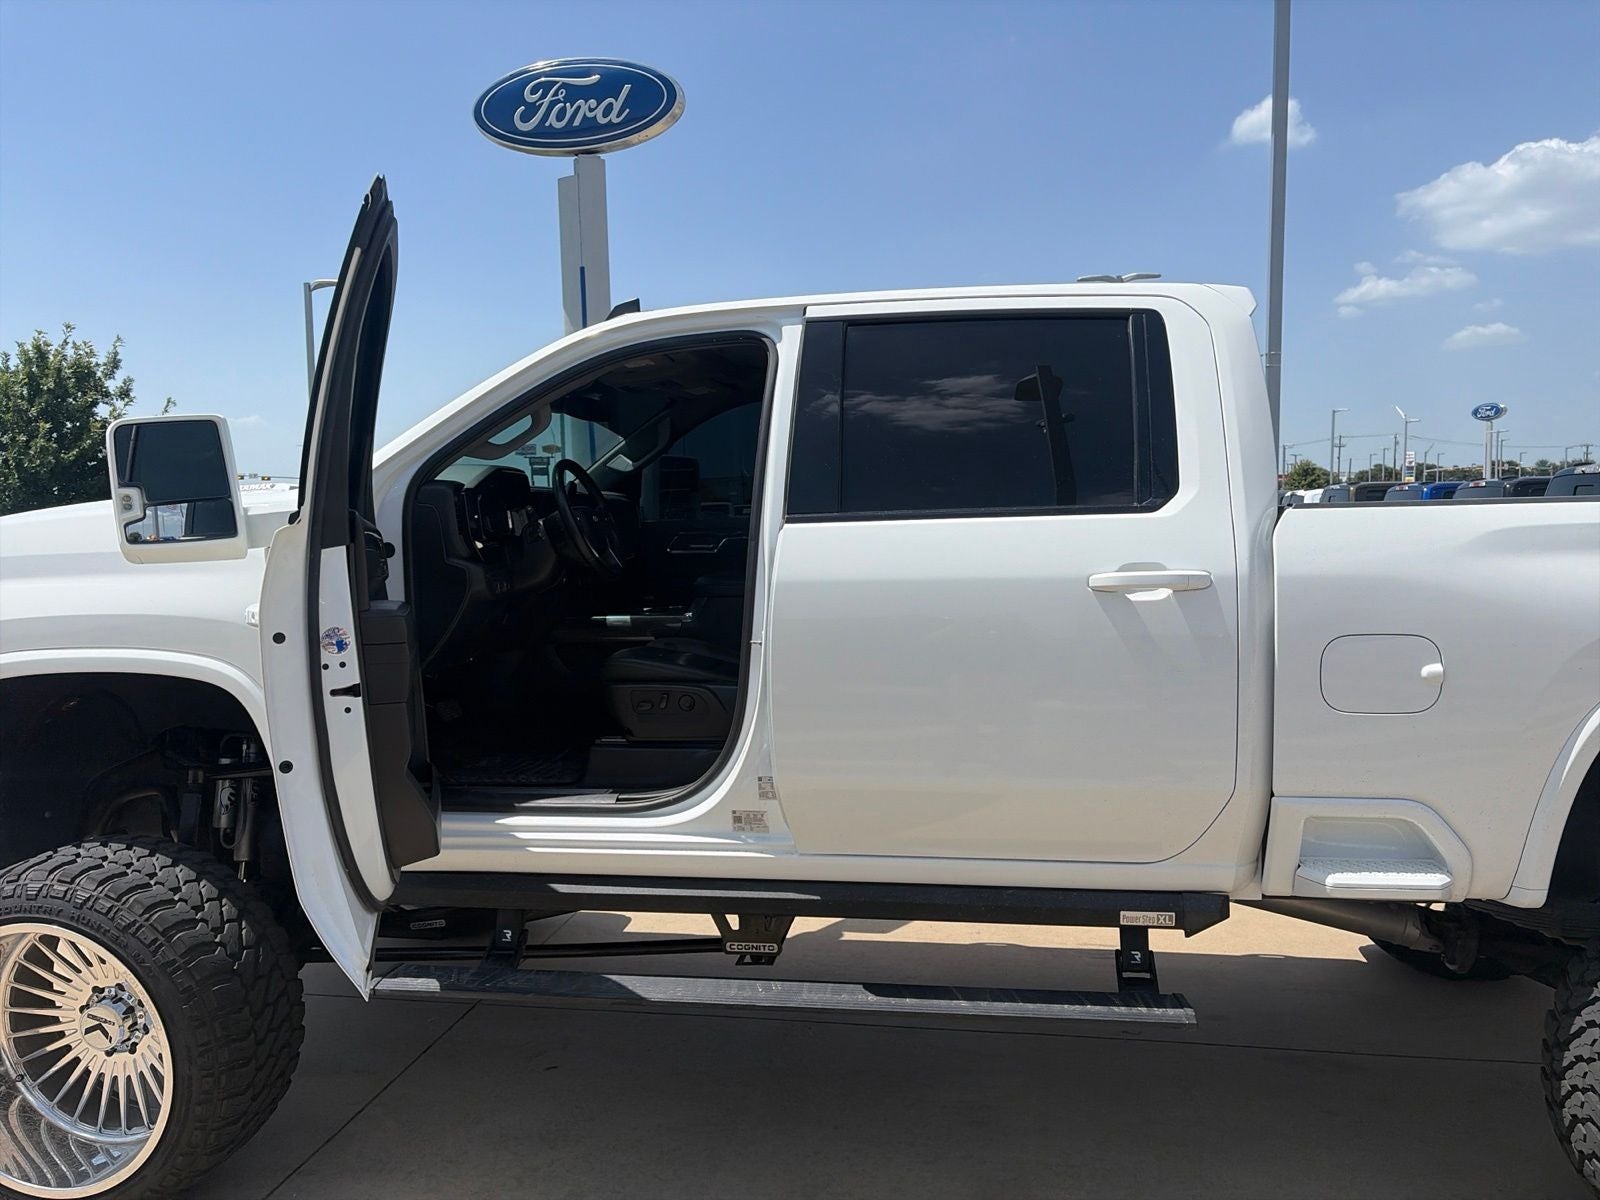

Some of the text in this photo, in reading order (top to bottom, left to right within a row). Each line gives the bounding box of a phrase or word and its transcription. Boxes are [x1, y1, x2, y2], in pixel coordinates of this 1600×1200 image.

[513, 74, 632, 132] Ford
[1476, 406, 1497, 418] Ford
[1158, 914, 1172, 924] XL
[728, 943, 775, 952] COGNITO
